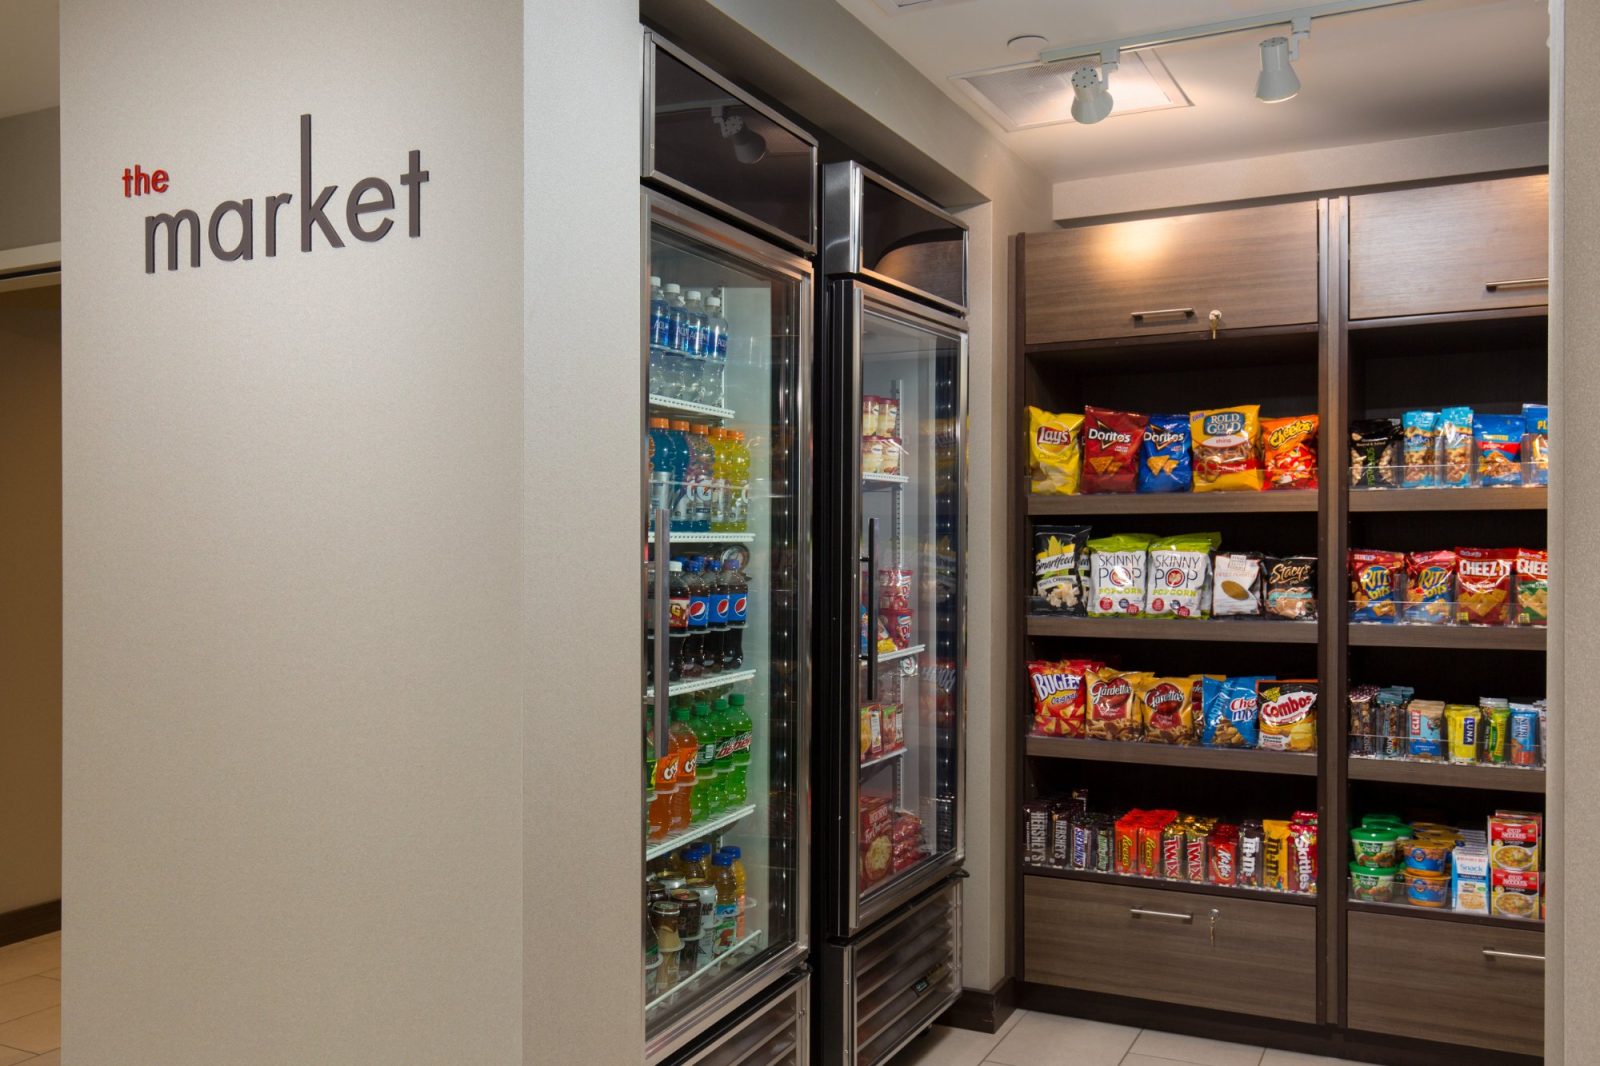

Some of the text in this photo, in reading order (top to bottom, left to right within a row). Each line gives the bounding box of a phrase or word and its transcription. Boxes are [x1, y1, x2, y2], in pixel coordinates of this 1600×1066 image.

[122, 164, 169, 198] the
[145, 114, 430, 275] market
[1207, 422, 1241, 434] GOLD
[1211, 413, 1241, 424] ROLD
[1038, 427, 1069, 445] Lay's
[1088, 428, 1132, 443] Doritos
[1143, 431, 1185, 442] Doritos
[1269, 420, 1313, 447] Cheetos
[1099, 554, 1142, 567] SKINNY
[1155, 555, 1200, 569] SKINNY
[1270, 562, 1313, 584] Stacy's
[1152, 588, 1197, 598] POPCORN
[1263, 694, 1313, 718] Combos
[1466, 719, 1474, 743] LUNA
[1031, 812, 1047, 862] HERSHEY'S
[1055, 820, 1067, 860] HERSHEY'S
[1164, 836, 1180, 878] TWIX
[1187, 837, 1203, 880] TWIX
[1294, 837, 1312, 890] Skittles
